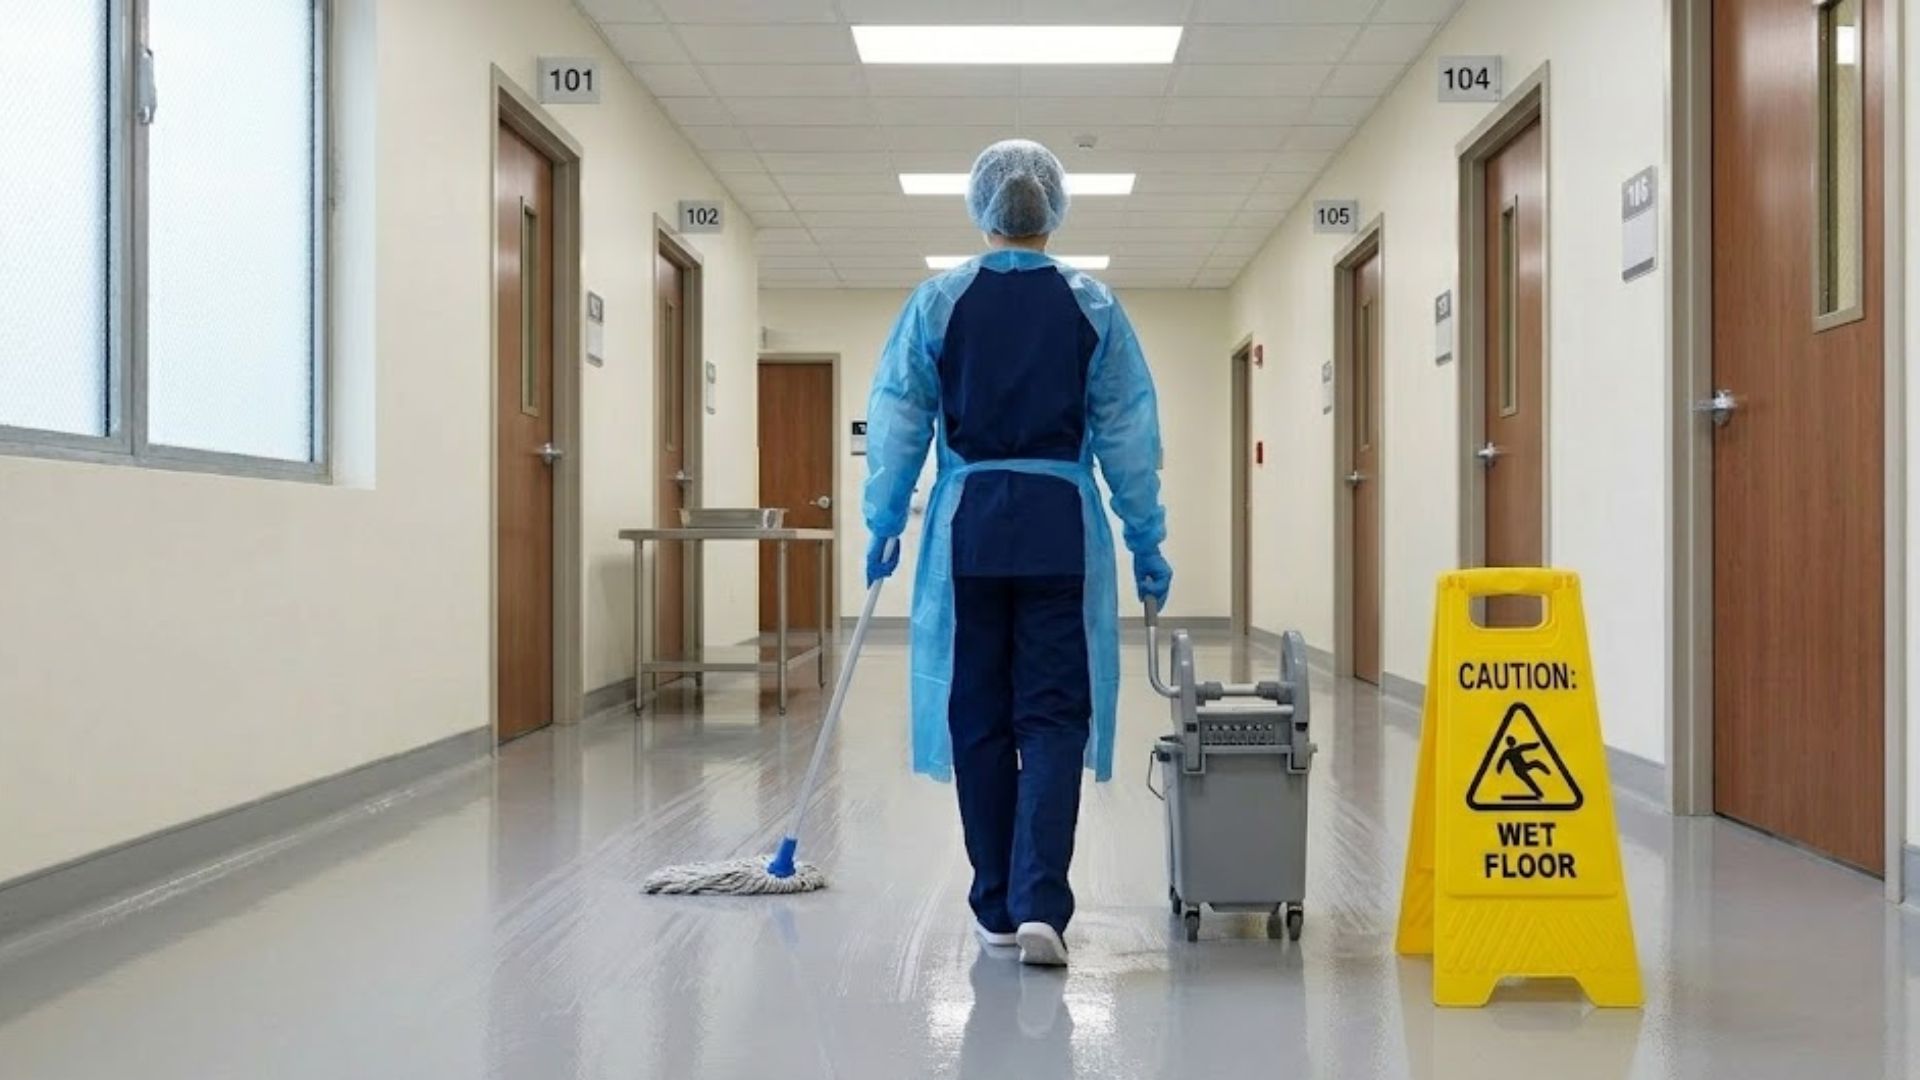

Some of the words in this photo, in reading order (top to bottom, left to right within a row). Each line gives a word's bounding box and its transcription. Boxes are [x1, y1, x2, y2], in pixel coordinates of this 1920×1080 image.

[549, 68, 593, 92] 101
[1443, 66, 1491, 91] 104
[686, 207, 719, 226] 102
[1318, 207, 1350, 226] 105
[1459, 662, 1577, 690] CAUTION:
[1497, 822, 1557, 847] WET
[1484, 853, 1577, 879] FLOOR
